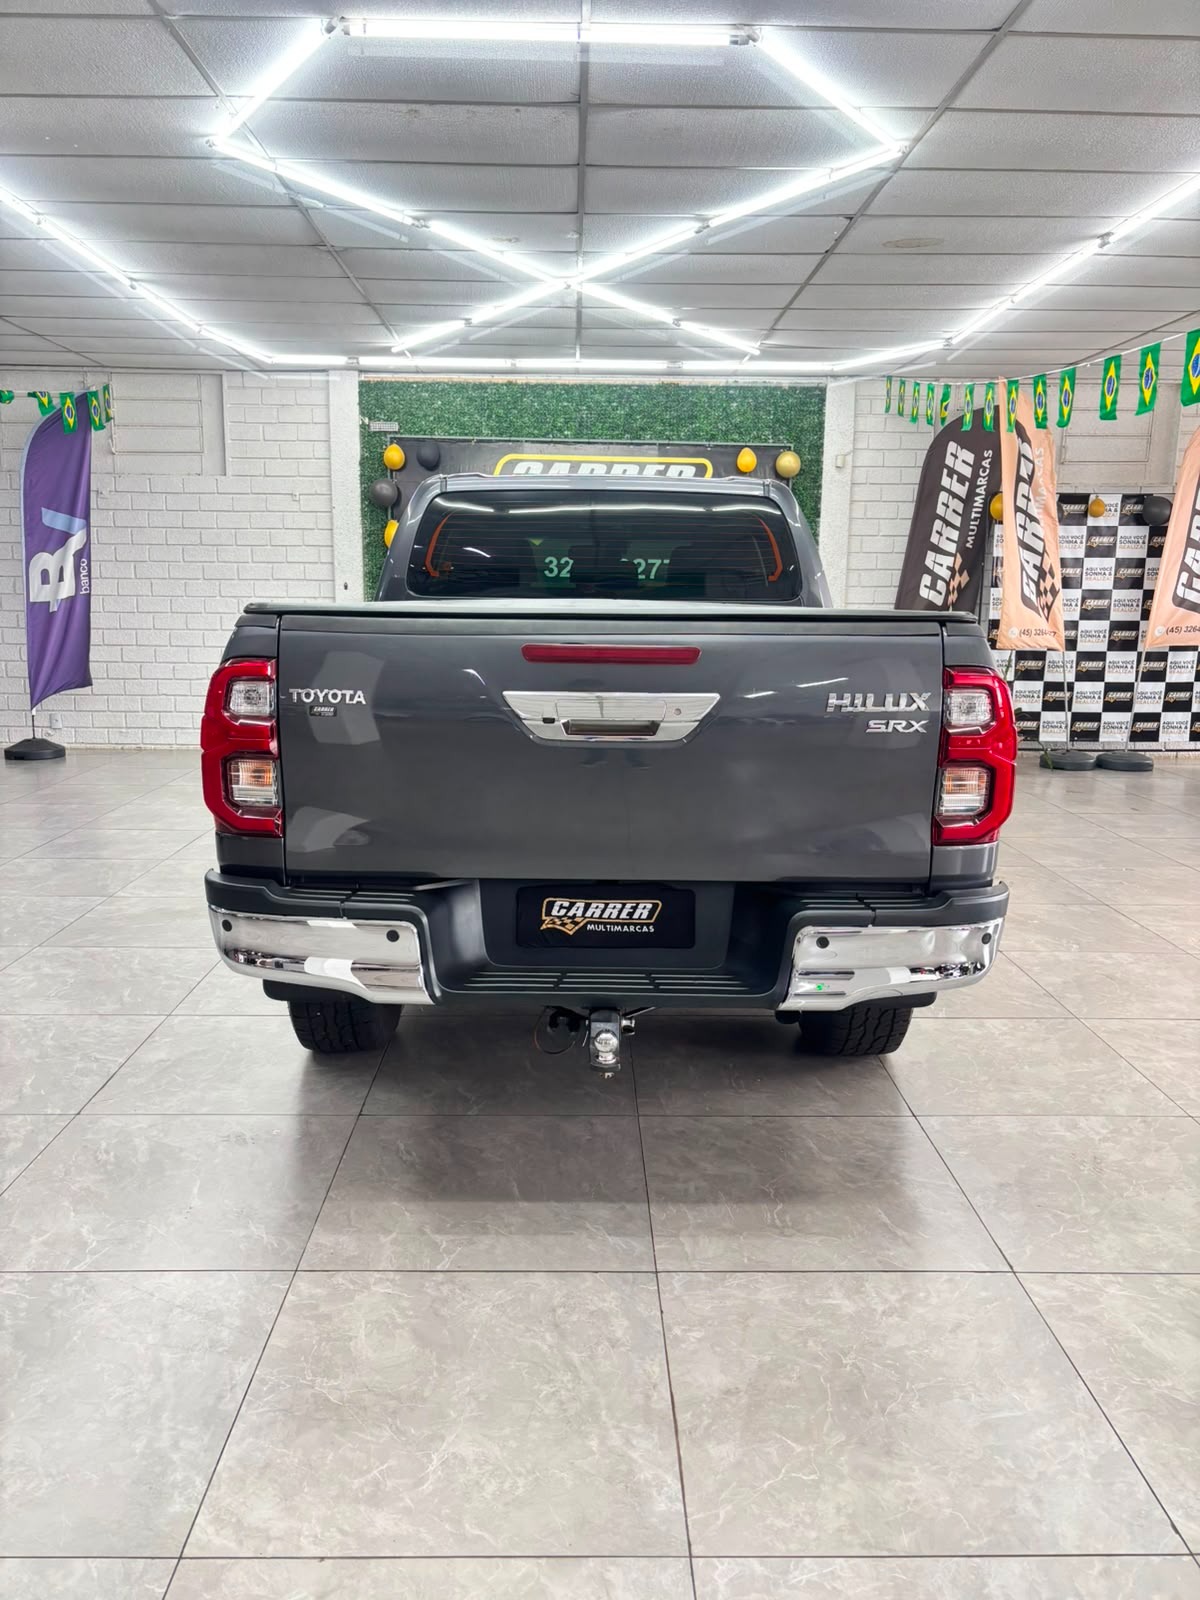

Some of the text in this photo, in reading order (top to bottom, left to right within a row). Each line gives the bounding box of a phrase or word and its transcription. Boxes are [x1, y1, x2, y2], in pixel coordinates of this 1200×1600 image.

[965, 449, 993, 549] MULTIMARCAS
[919, 440, 976, 607] CARRER
[79, 558, 90, 594] banco
[1166, 626, 1182, 635] (45)
[288, 688, 366, 704] TOYOTA
[826, 693, 931, 712] HILUX
[866, 720, 929, 733] SRX
[551, 901, 653, 919] CARRER
[586, 924, 655, 932] MULTIMARCAS
